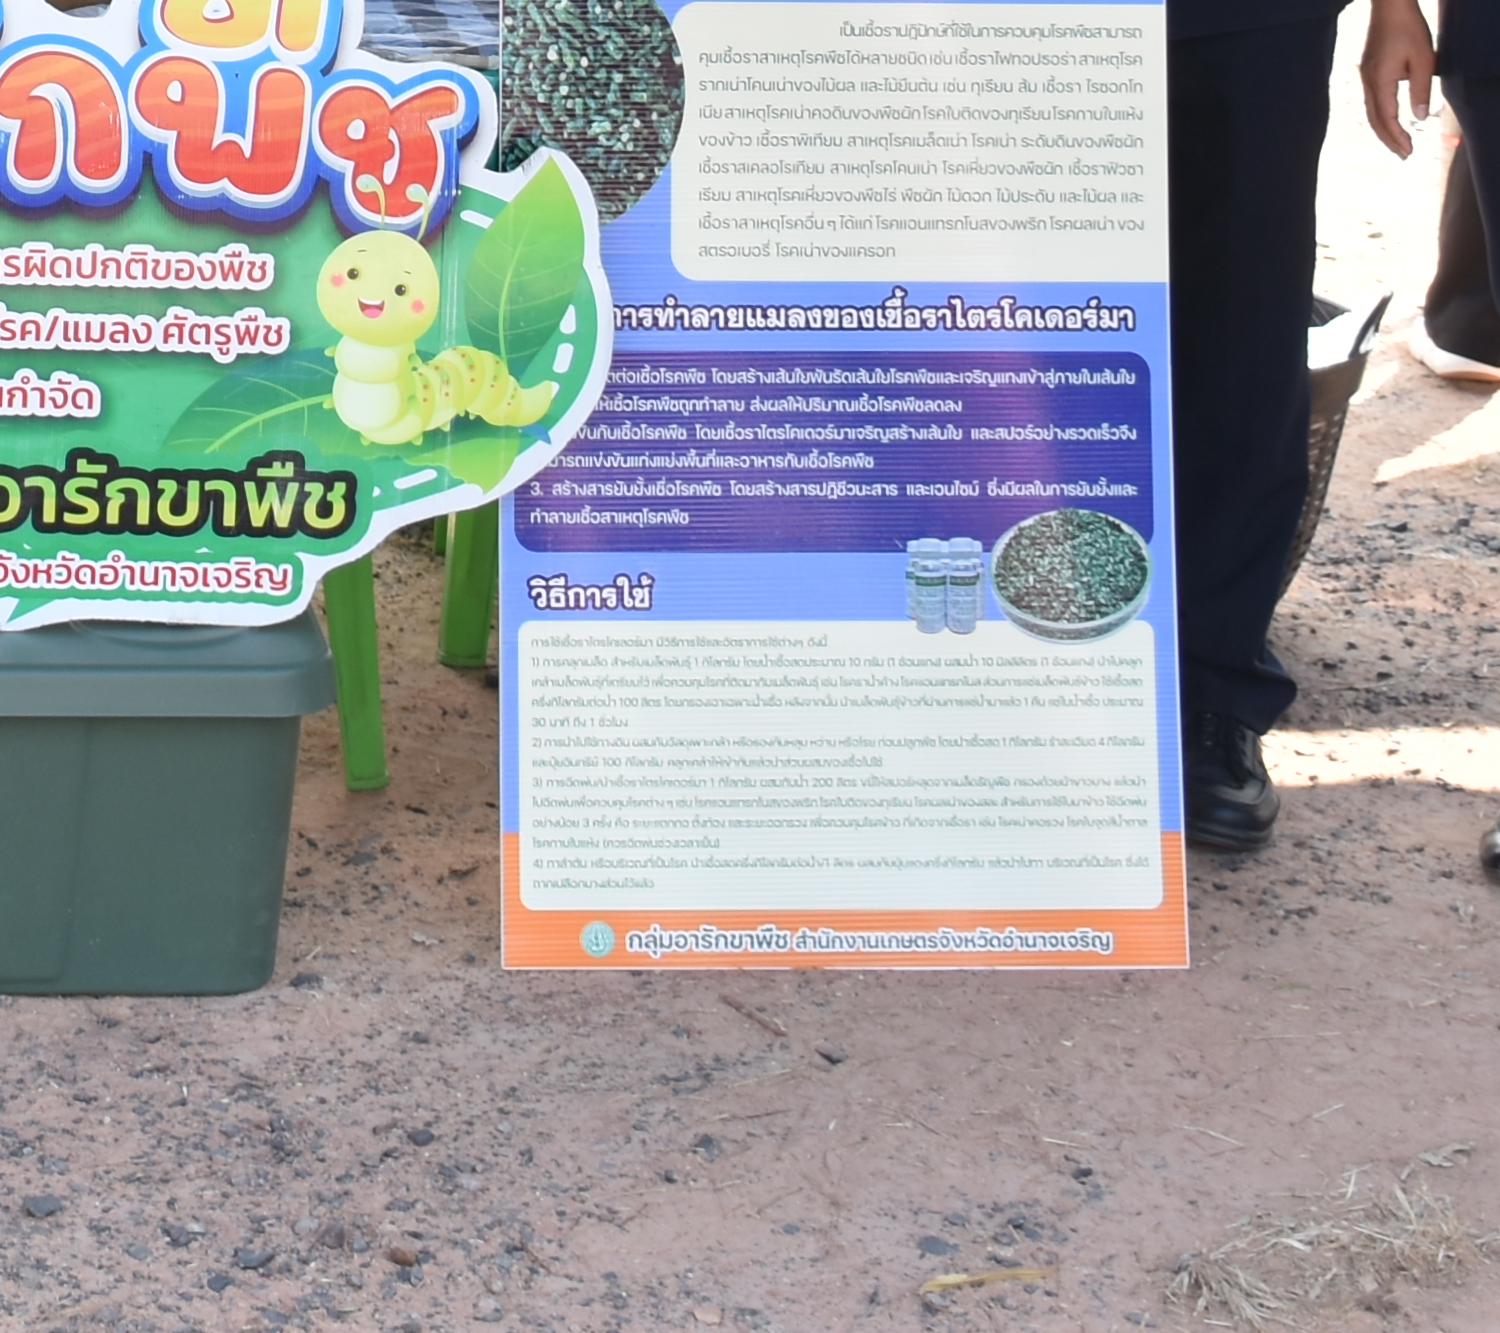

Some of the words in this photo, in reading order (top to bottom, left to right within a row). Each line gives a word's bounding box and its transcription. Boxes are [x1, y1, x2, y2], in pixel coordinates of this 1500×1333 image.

[942, 78, 966, 93] เช่น
[970, 78, 1013, 96] ทุเรียน
[1017, 78, 1037, 93] ส้ม
[1121, 191, 1144, 203] และ
[1118, 219, 1144, 231] ของ
[161, 311, 285, 360] ศัตรูพืช
[530, 482, 543, 496] 3.
[529, 575, 654, 610] วิธีการใช้
[626, 925, 788, 958] กลุ่มอารักขาพืช
[794, 929, 1110, 954] สำนักงานเกษตรจังหวัดอำนาจเจริญ
